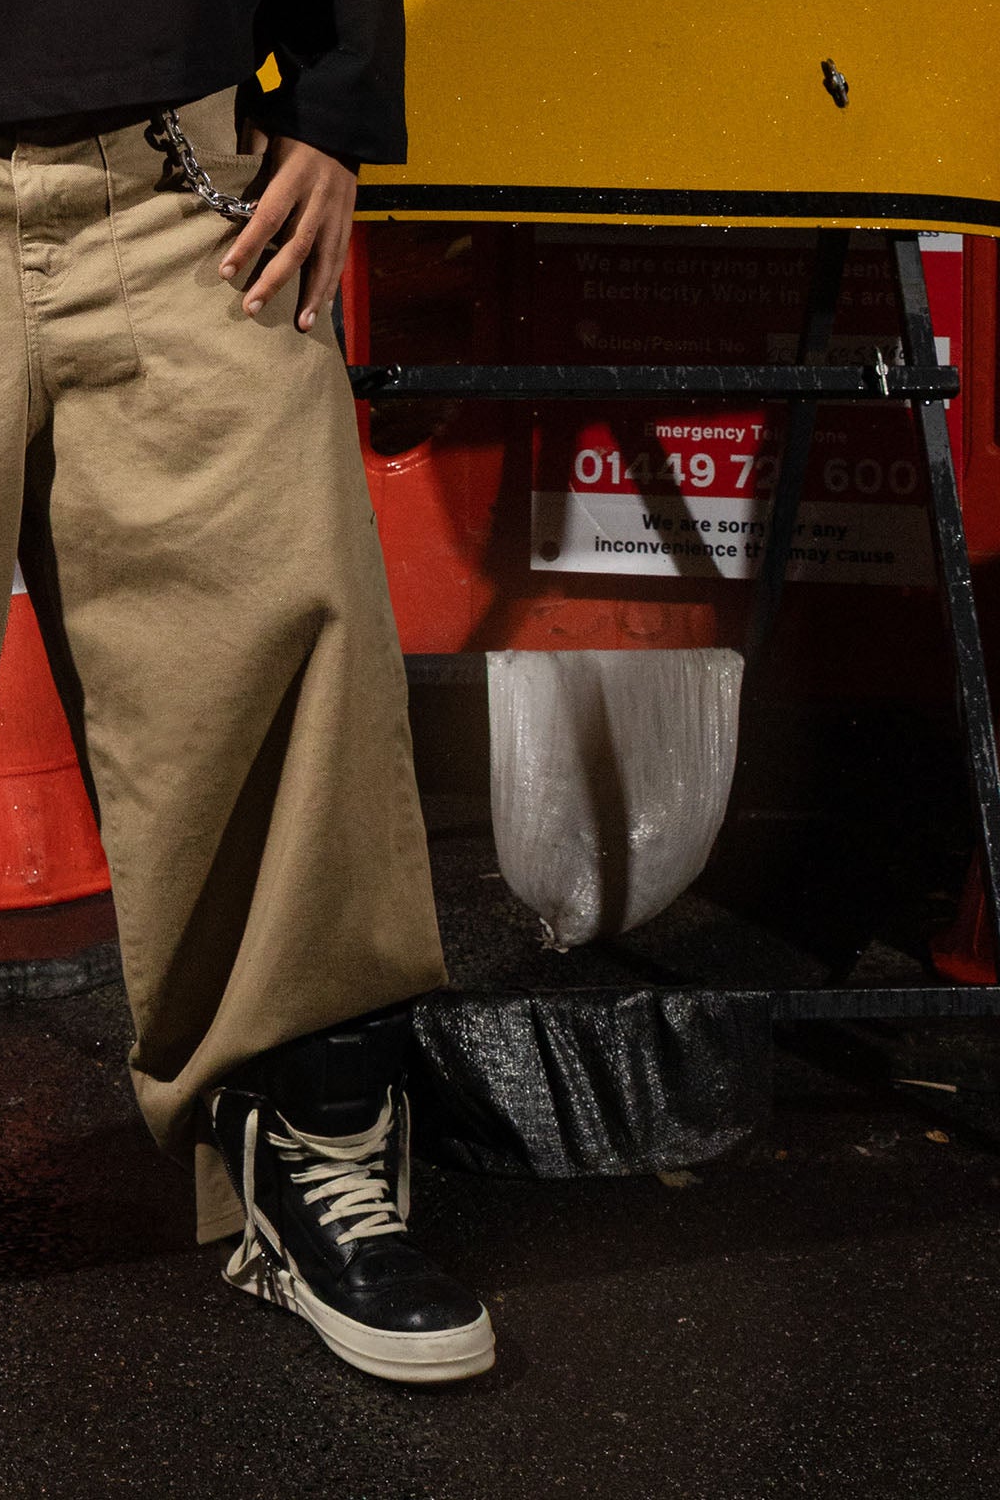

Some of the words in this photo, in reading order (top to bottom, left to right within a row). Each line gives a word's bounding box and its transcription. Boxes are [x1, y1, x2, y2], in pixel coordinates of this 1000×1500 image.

[644, 422, 746, 443] Emergency
[575, 448, 716, 489] 01449
[823, 458, 918, 495] 600
[643, 514, 674, 531] We
[680, 518, 711, 532] are
[813, 523, 848, 541] any
[595, 536, 737, 558] inconvenience
[836, 548, 895, 563] cause
